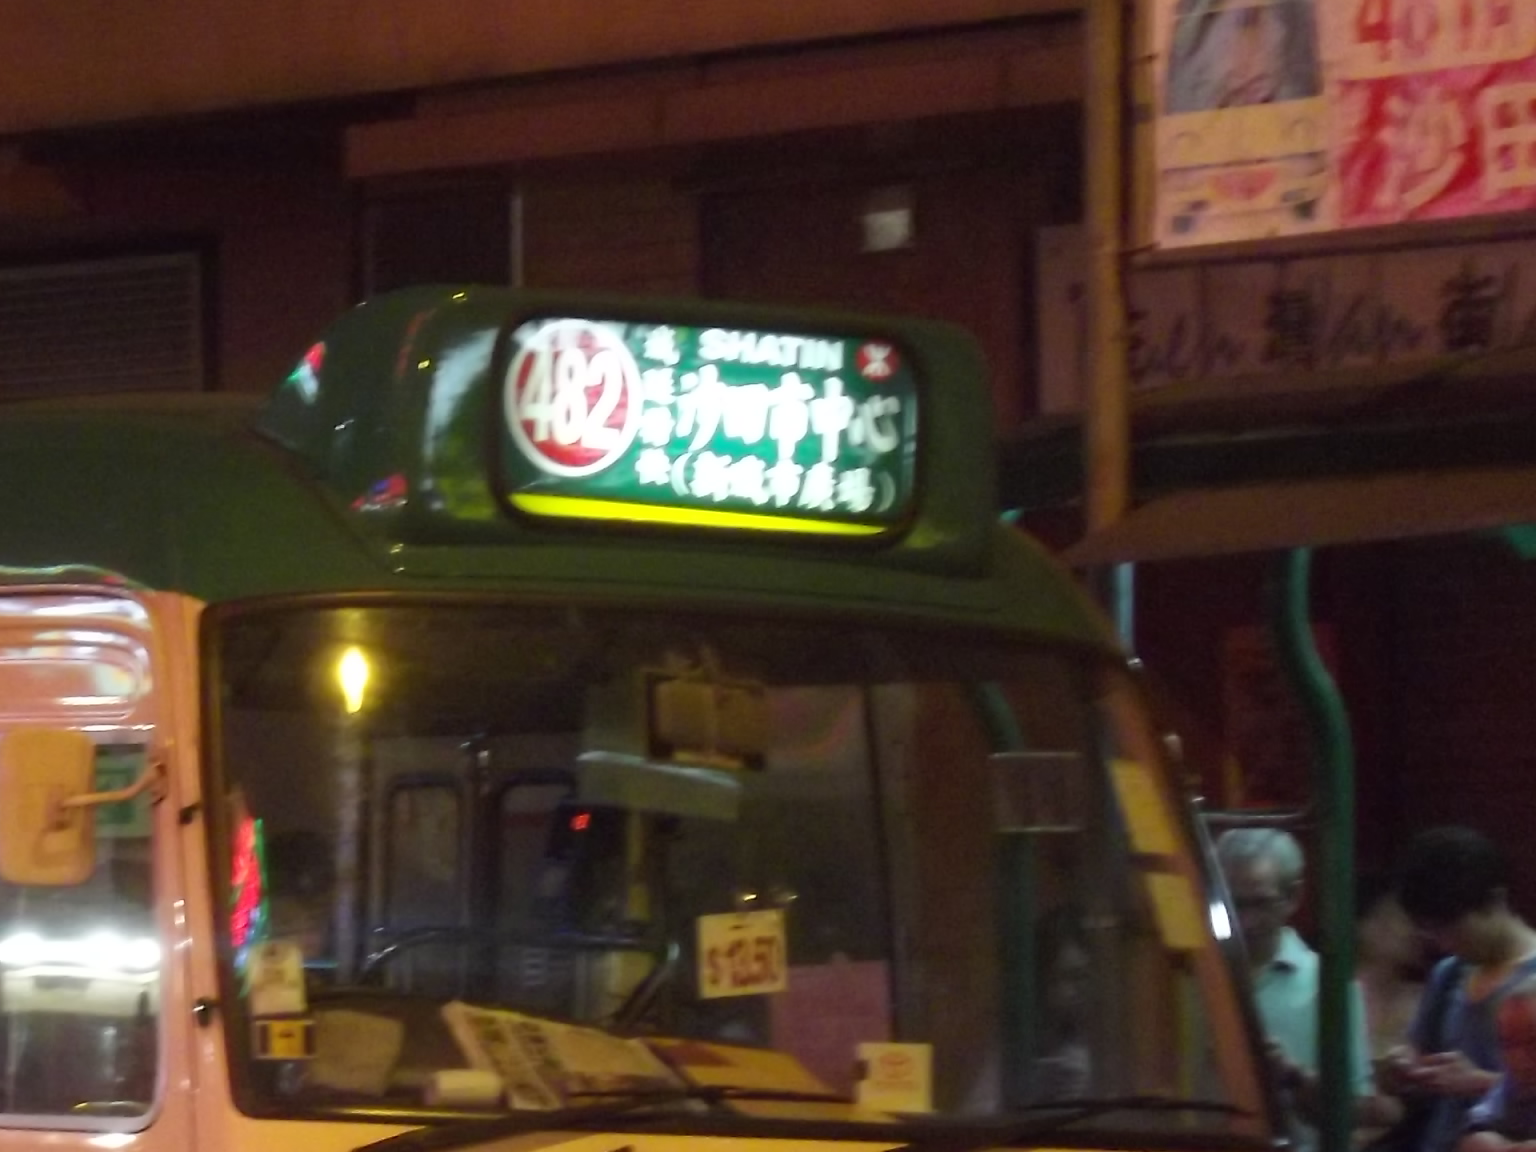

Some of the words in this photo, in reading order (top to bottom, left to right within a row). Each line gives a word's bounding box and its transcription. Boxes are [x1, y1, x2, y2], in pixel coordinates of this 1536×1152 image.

[519, 347, 623, 451] 482
[676, 363, 901, 463] 沙田市中心
